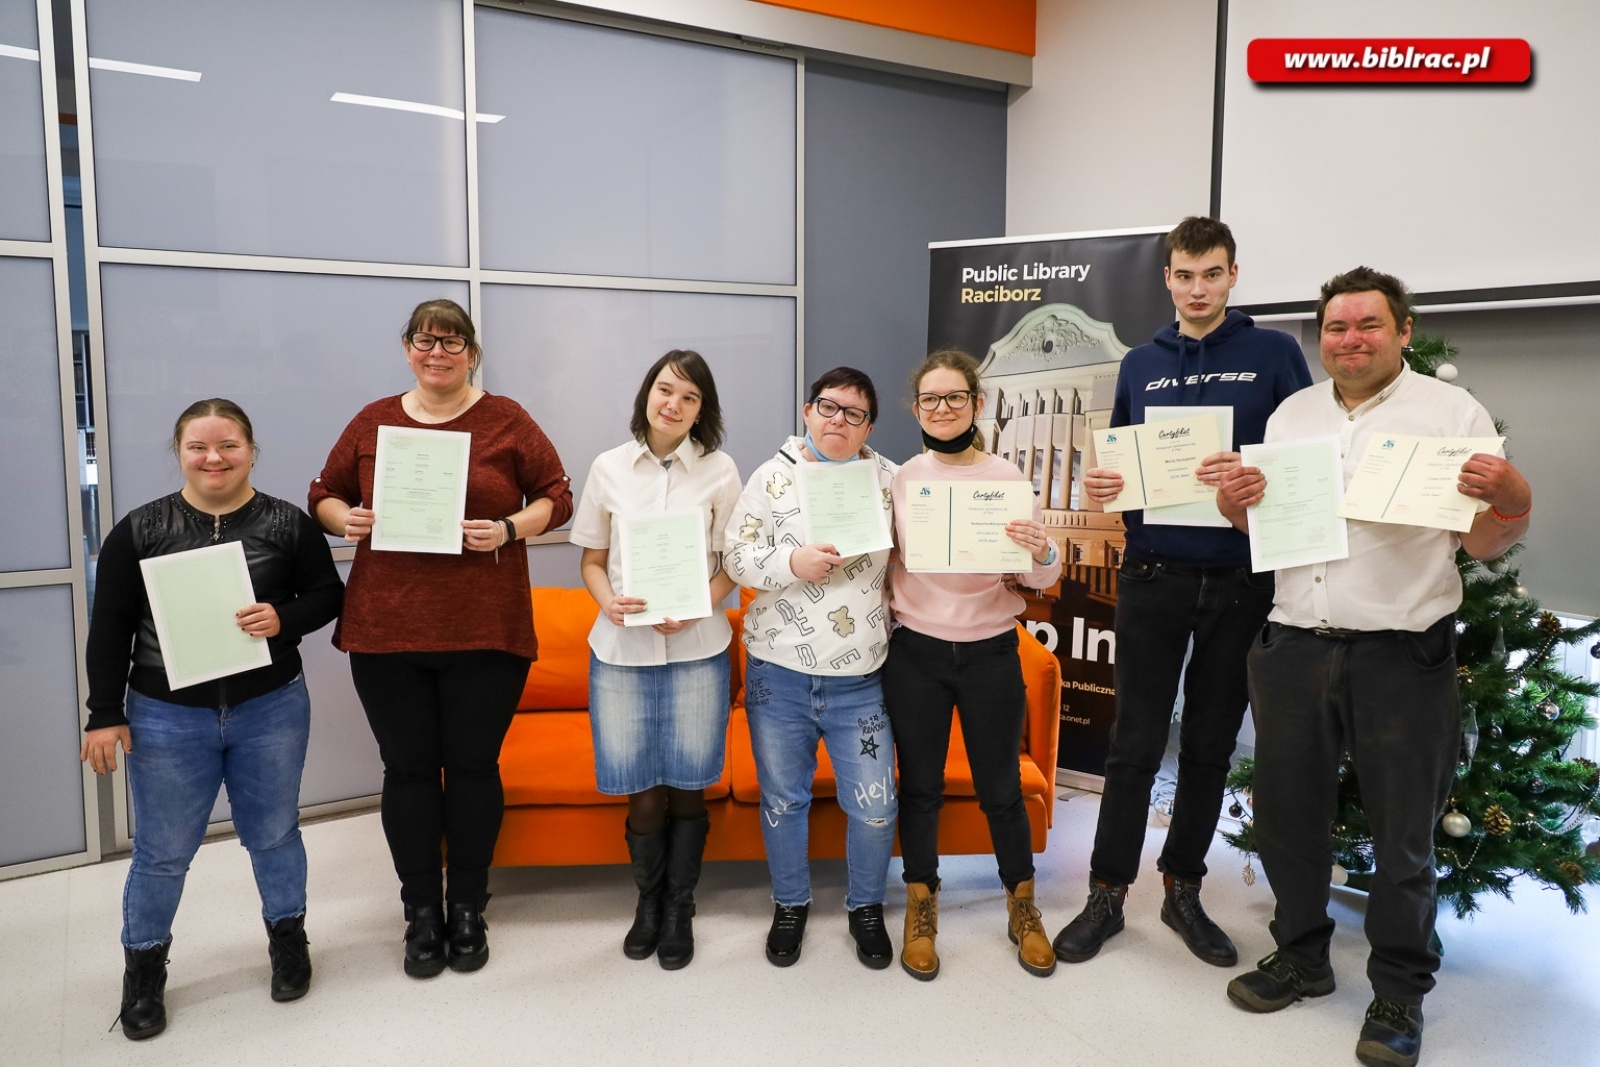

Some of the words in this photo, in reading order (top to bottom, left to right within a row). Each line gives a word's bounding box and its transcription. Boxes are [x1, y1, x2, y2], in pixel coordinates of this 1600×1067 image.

[962, 264, 1018, 283] Public
[1023, 262, 1091, 282] Library
[961, 285, 1042, 303] Raciborz
[1072, 617, 1116, 665] In
[1072, 681, 1116, 696] Publiczna
[854, 767, 895, 809] Hey!
